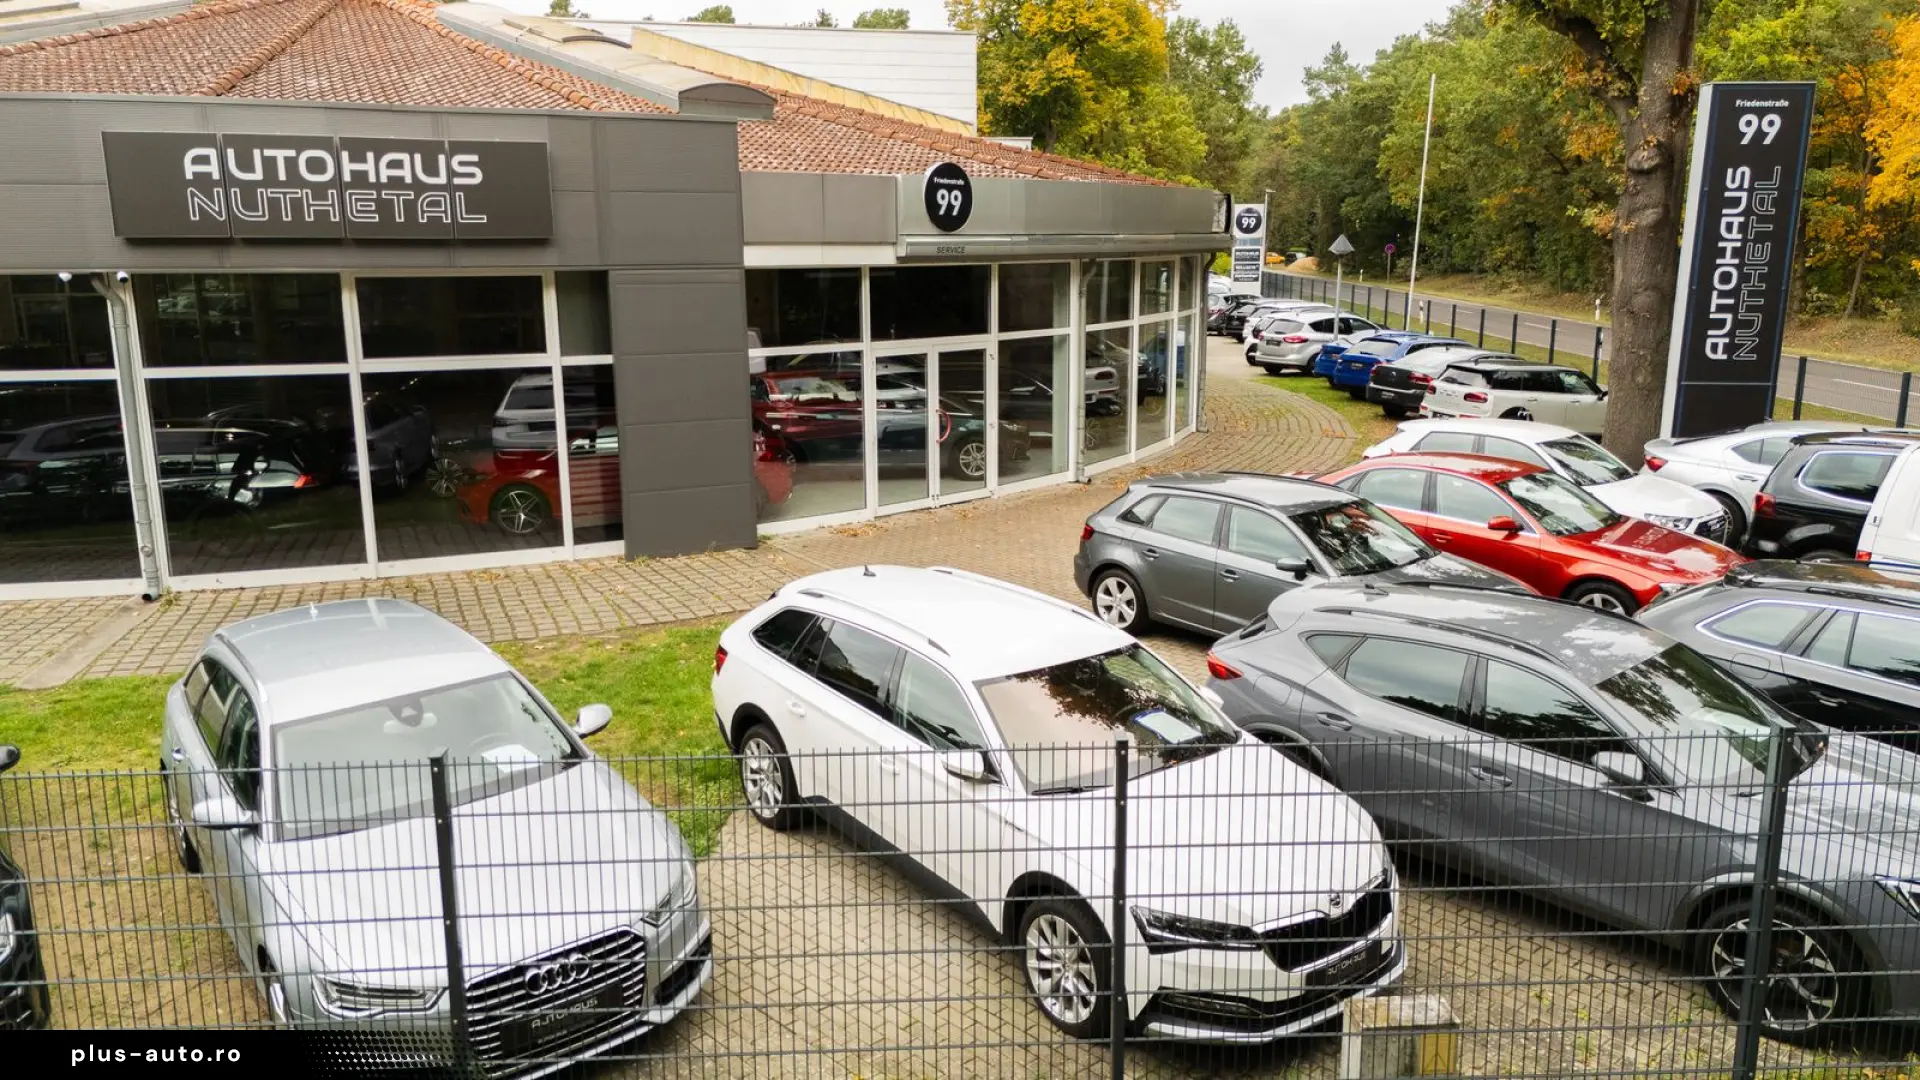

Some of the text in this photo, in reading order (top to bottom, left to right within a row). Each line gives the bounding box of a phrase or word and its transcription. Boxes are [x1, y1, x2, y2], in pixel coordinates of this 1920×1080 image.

[1735, 99, 1790, 108] Friedenstraße
[1738, 113, 1782, 145] 99
[183, 147, 483, 185] AUTOHAUS
[186, 187, 487, 223] NUTHETAL
[936, 188, 962, 216] 99
[1241, 217, 1256, 229] 99
[936, 246, 966, 254] SERVICE
[1705, 165, 1751, 361] AUTOHAUS
[1732, 165, 1782, 361] NUTHETAL
